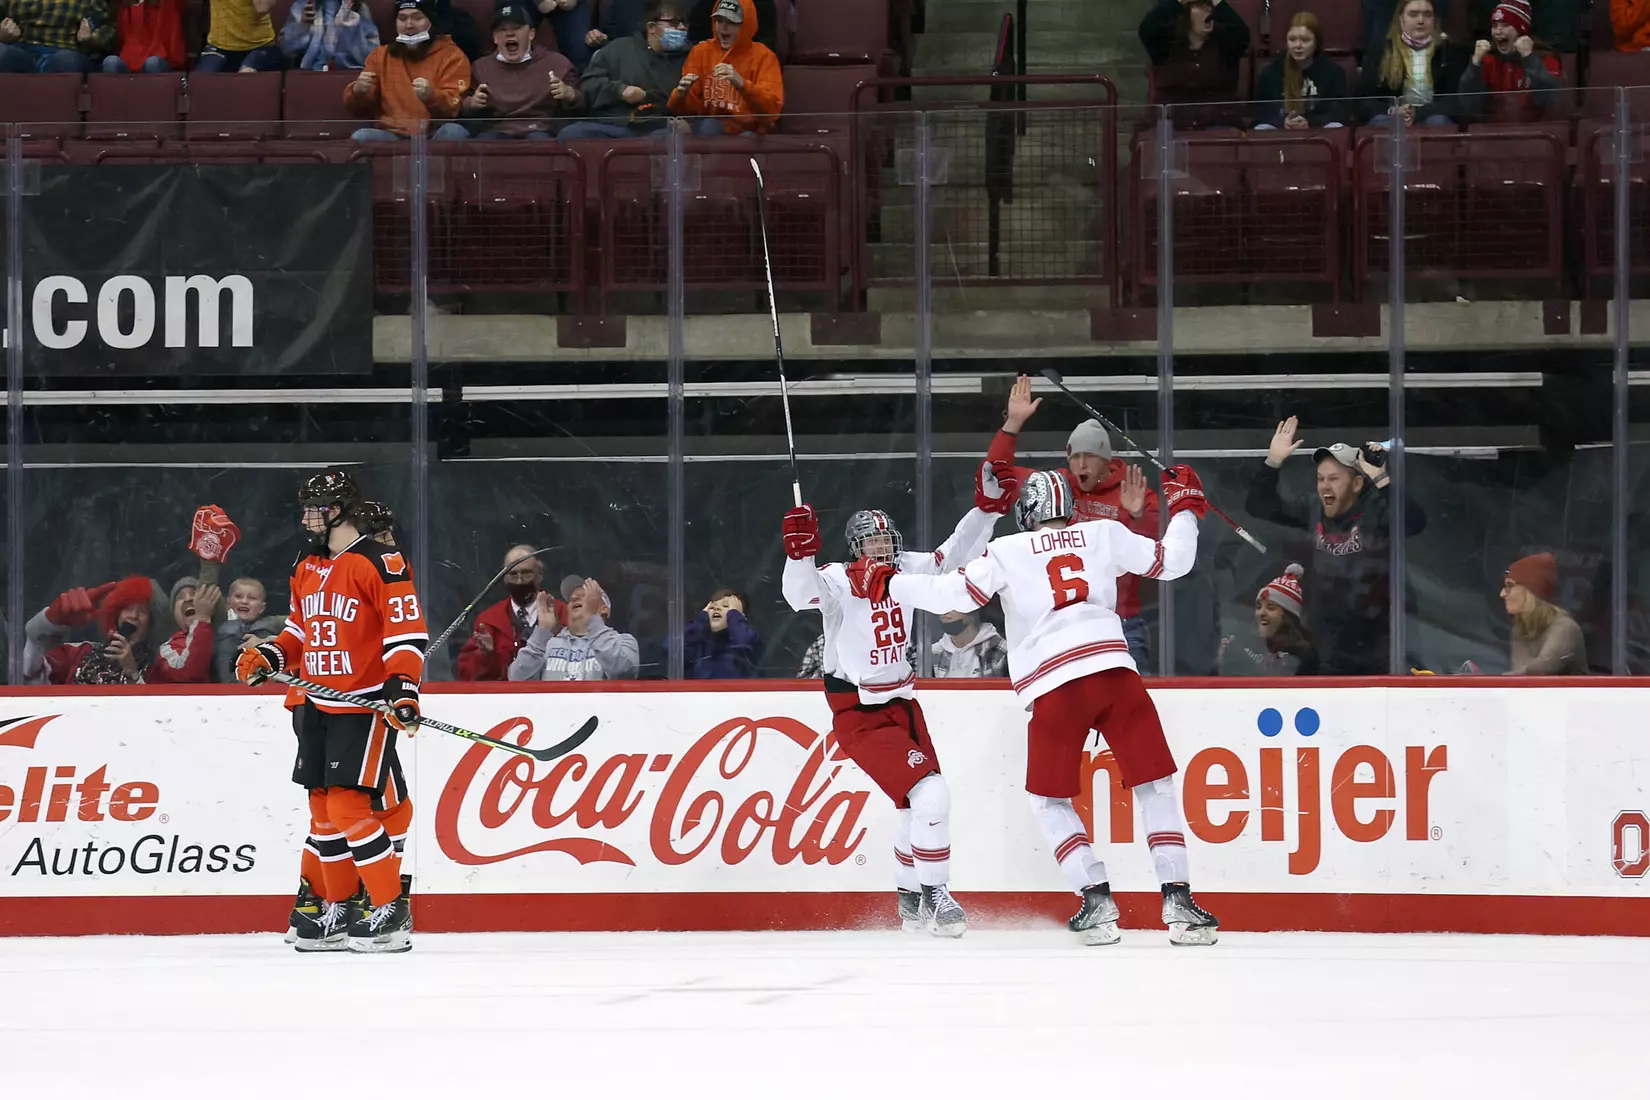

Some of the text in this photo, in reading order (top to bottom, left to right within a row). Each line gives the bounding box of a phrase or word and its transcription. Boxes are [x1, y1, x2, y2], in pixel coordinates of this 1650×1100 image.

[3, 274, 254, 349] com
[1031, 530, 1086, 554] LOHREI
[1046, 553, 1089, 611] 6
[388, 594, 420, 623] 33
[310, 621, 337, 647] 33
[871, 607, 907, 648] 29
[304, 650, 353, 676] GREEN
[870, 642, 908, 665] STAT
[420, 718, 455, 733] ALPHA
[0, 763, 161, 823] lite
[434, 716, 871, 867] Coca-Cola
[11, 834, 257, 876] AutoGlass
